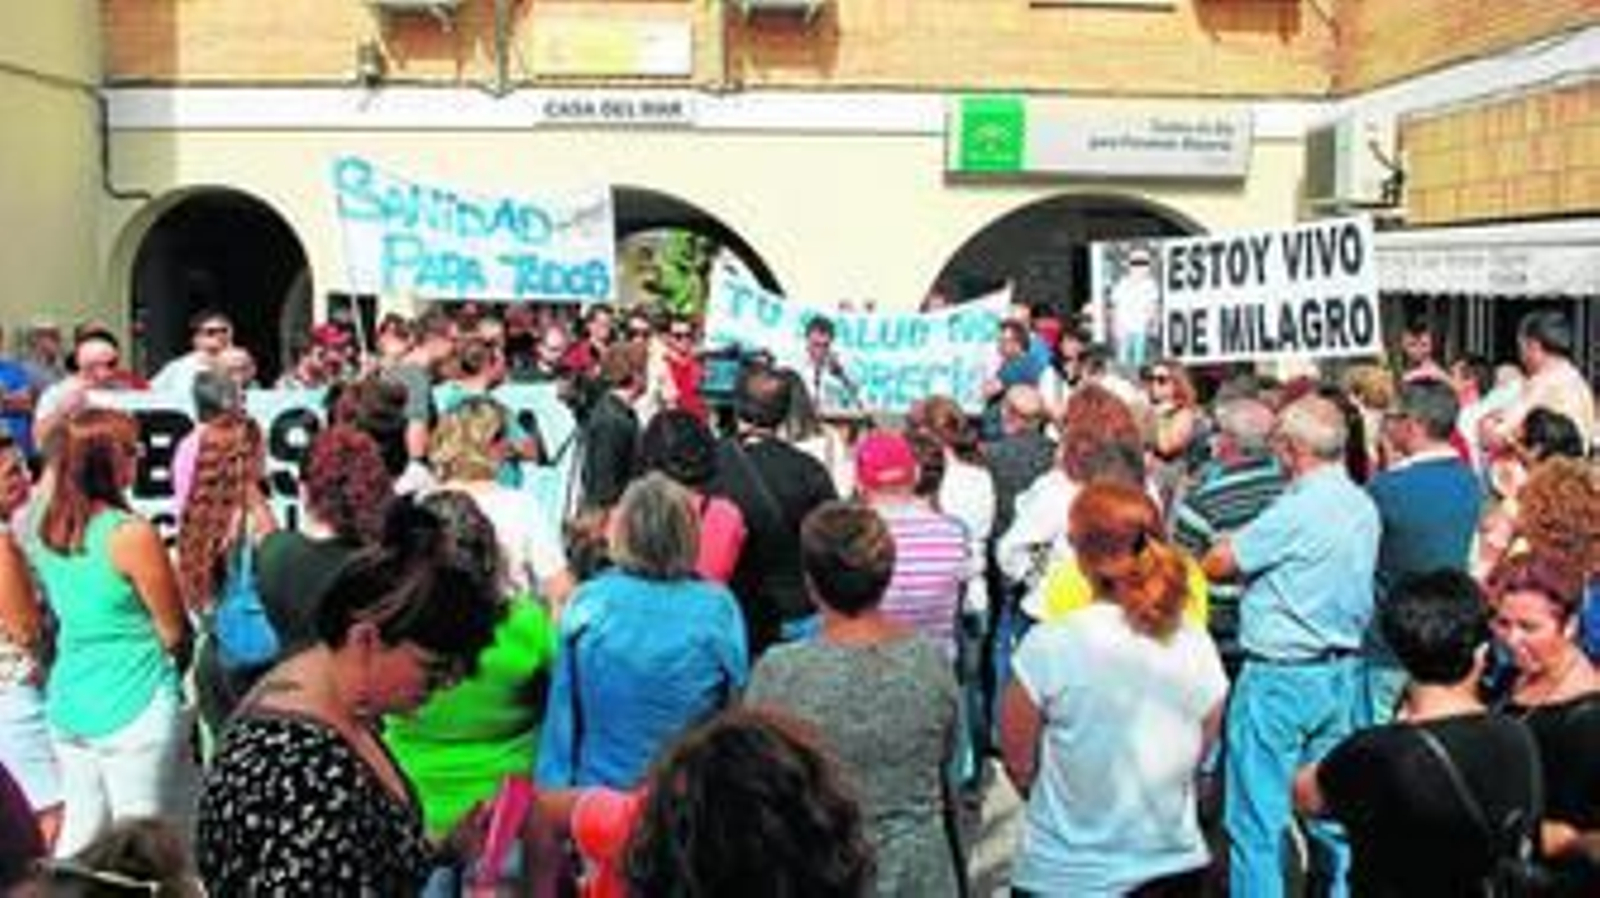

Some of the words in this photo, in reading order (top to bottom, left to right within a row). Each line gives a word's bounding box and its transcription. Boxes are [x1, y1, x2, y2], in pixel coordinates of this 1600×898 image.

[1167, 234, 1271, 291] ESTOY
[1281, 221, 1364, 281] VIVO
[1168, 306, 1208, 357] DE
[1219, 294, 1374, 353] MILAGRO
